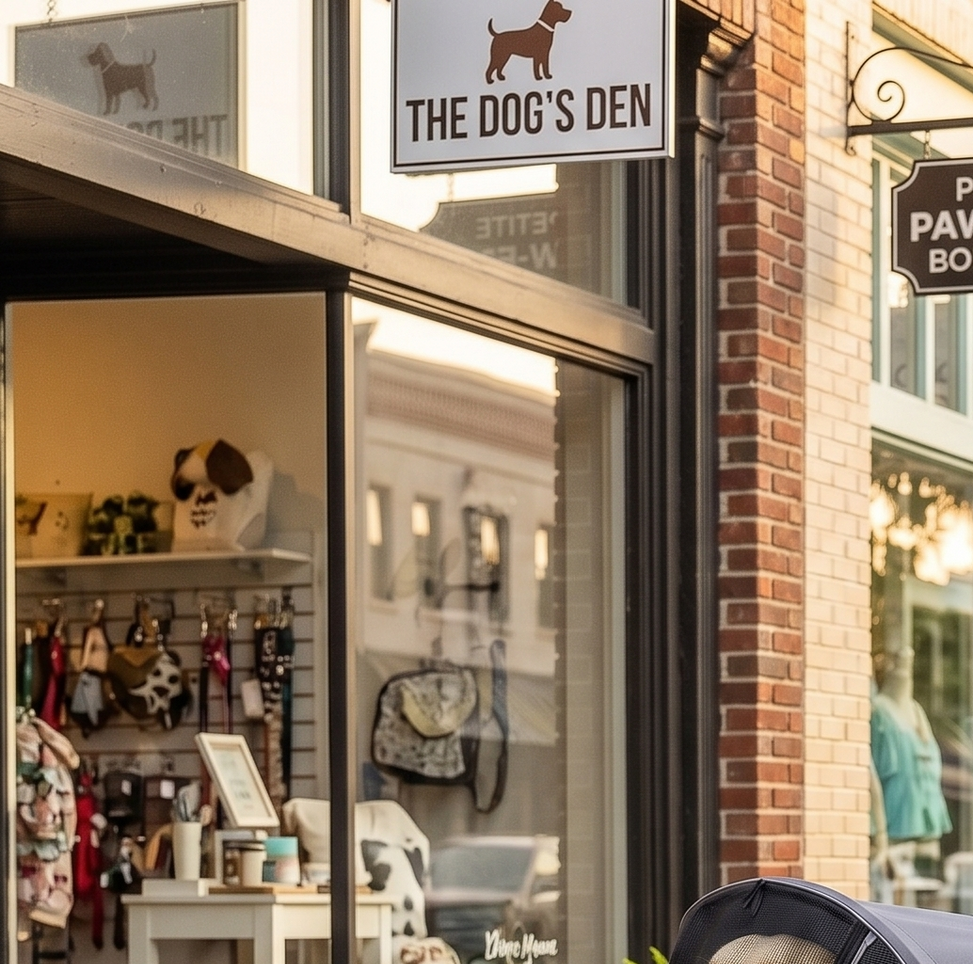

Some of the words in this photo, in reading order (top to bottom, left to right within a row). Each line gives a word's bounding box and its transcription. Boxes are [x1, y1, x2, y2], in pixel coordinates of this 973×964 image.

[405, 96, 469, 142] THE
[479, 88, 576, 138] DOG'S
[586, 83, 652, 130] DEN
